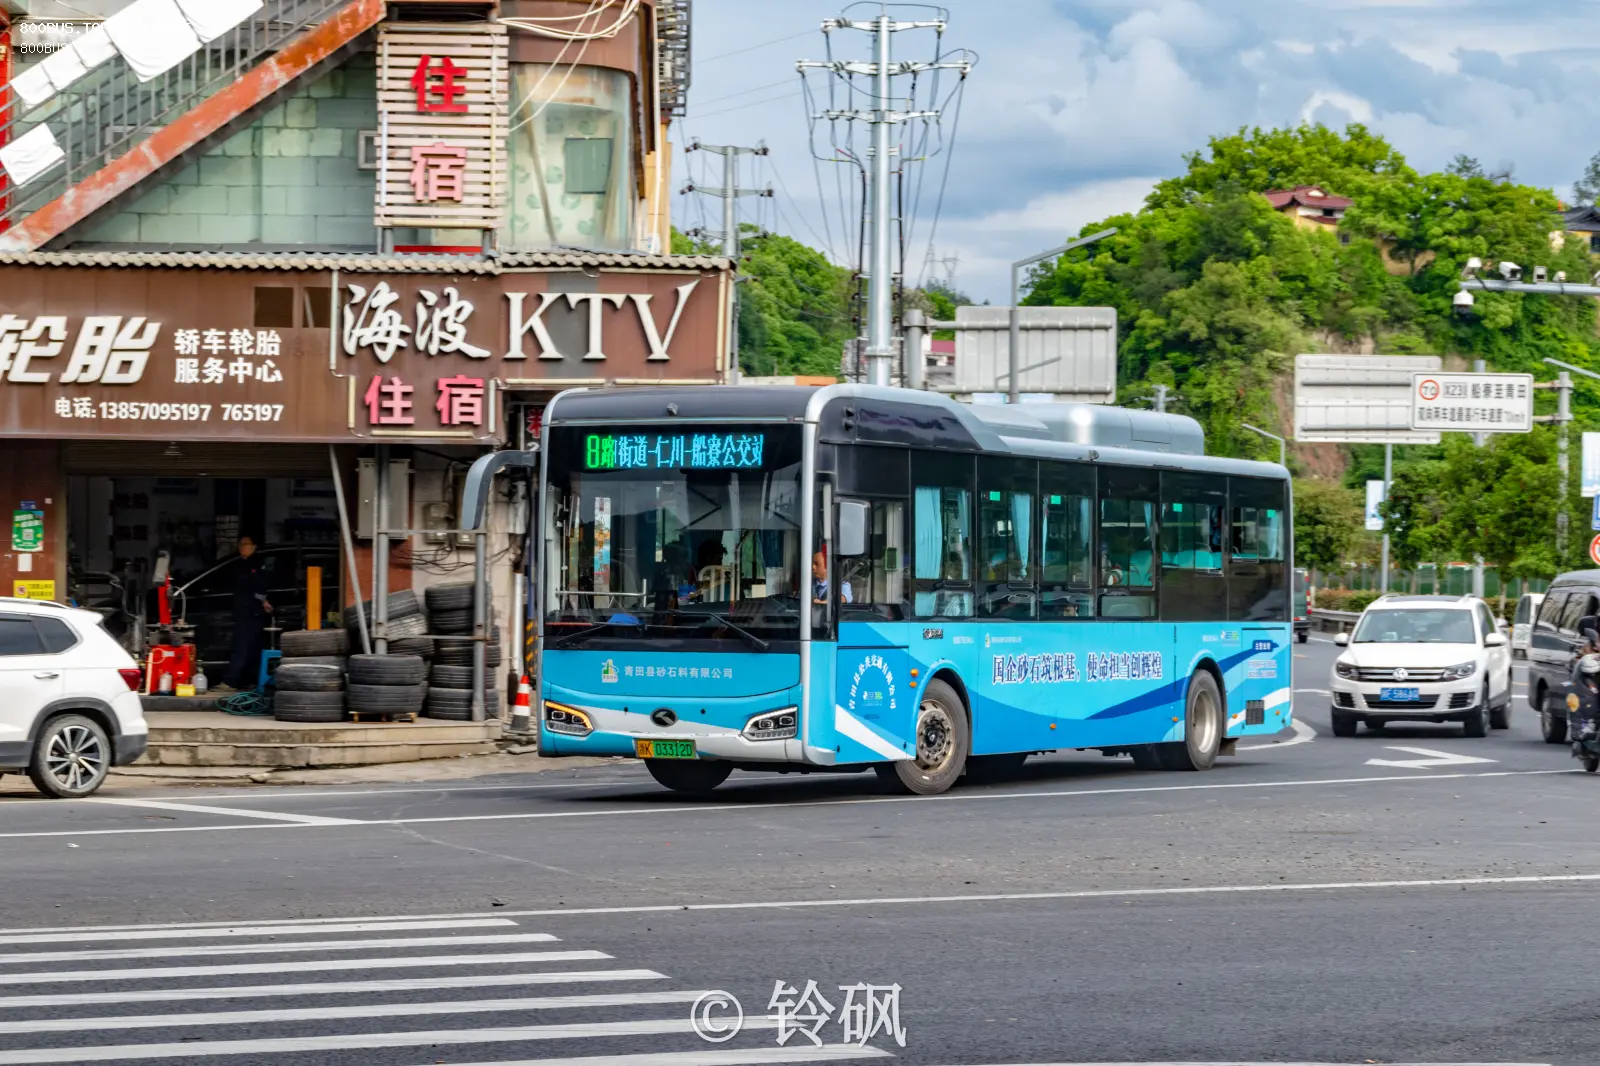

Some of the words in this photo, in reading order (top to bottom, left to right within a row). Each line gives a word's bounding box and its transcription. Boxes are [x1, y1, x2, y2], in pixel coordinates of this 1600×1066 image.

[410, 54, 468, 202] 住宿
[342, 280, 491, 363] 海波
[503, 279, 700, 362] KTV
[0, 314, 162, 384] 轮胎
[174, 328, 282, 356] 轿车轮胎
[174, 357, 283, 384] 服务中心
[221, 403, 284, 422] 765197
[364, 374, 484, 426] 住宿
[623, 665, 733, 679] 青田县砂石料有限公司
